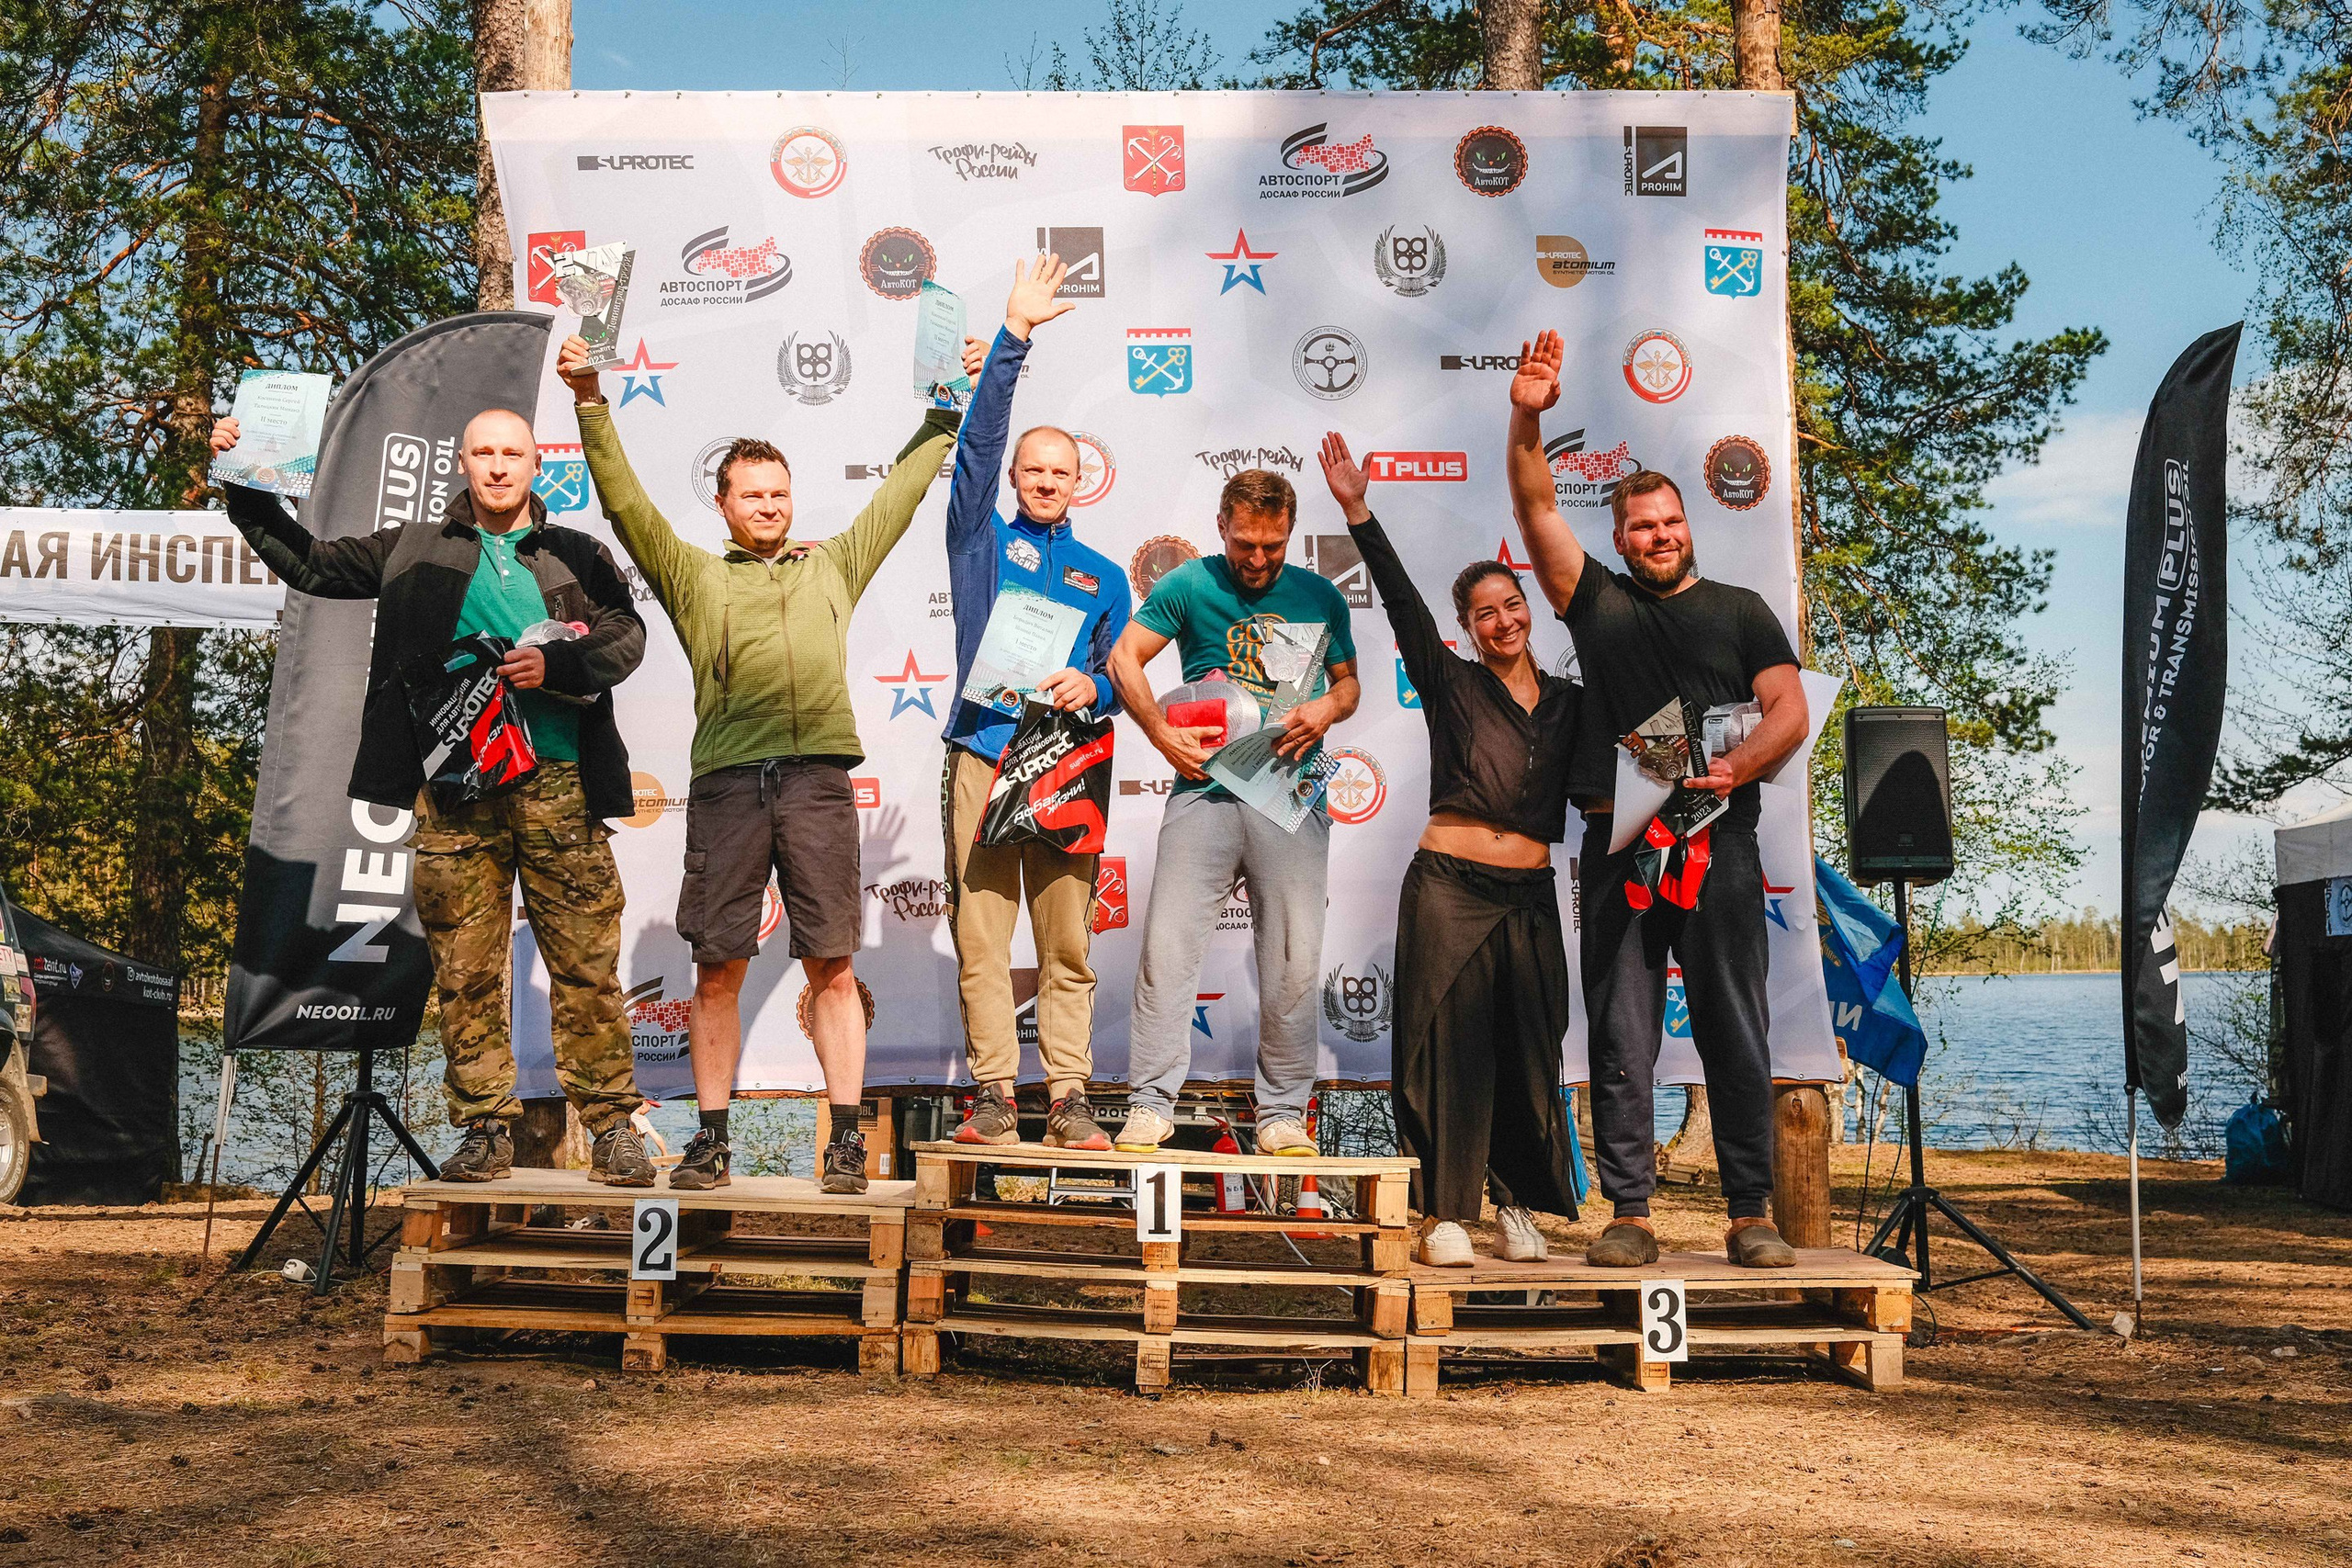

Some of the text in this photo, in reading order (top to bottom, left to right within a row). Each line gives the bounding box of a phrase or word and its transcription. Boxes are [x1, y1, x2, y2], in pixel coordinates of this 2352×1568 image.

[595, 155, 695, 170] SUPROTEC
[955, 157, 1018, 181] России
[1623, 146, 1634, 197] SUPROTEC
[1259, 175, 1340, 186] АВТОСПОРТ
[1641, 182, 1682, 192] PROHIM
[1260, 190, 1340, 199] ДОСААФ РОССИИ
[1552, 260, 1616, 270] atomium
[660, 280, 742, 293] АВТОСПОРТ
[661, 296, 743, 307] ДОСААФ РОССИИ
[587, 354, 606, 366] 023
[1460, 355, 1522, 370] SUPRO
[1555, 483, 1598, 494] СПОРТ
[1561, 500, 1599, 508] РОССИИ
[2159, 468, 2188, 584] PLUS
[1005, 547, 1038, 572] РОССИИ
[1344, 594, 1368, 604] HIM
[1009, 731, 1075, 782] SUPROEC
[633, 788, 658, 796] ROTEC
[1690, 804, 1713, 823] 2023
[893, 896, 947, 921] Росси
[296, 1004, 396, 1021] NEOOIL.RU
[632, 1035, 676, 1047] СПОРТ
[638, 1053, 675, 1061] РОССИИ
[1147, 1170, 1172, 1235] 1
[638, 1207, 673, 1271] 2
[1647, 1287, 1683, 1354] 3
